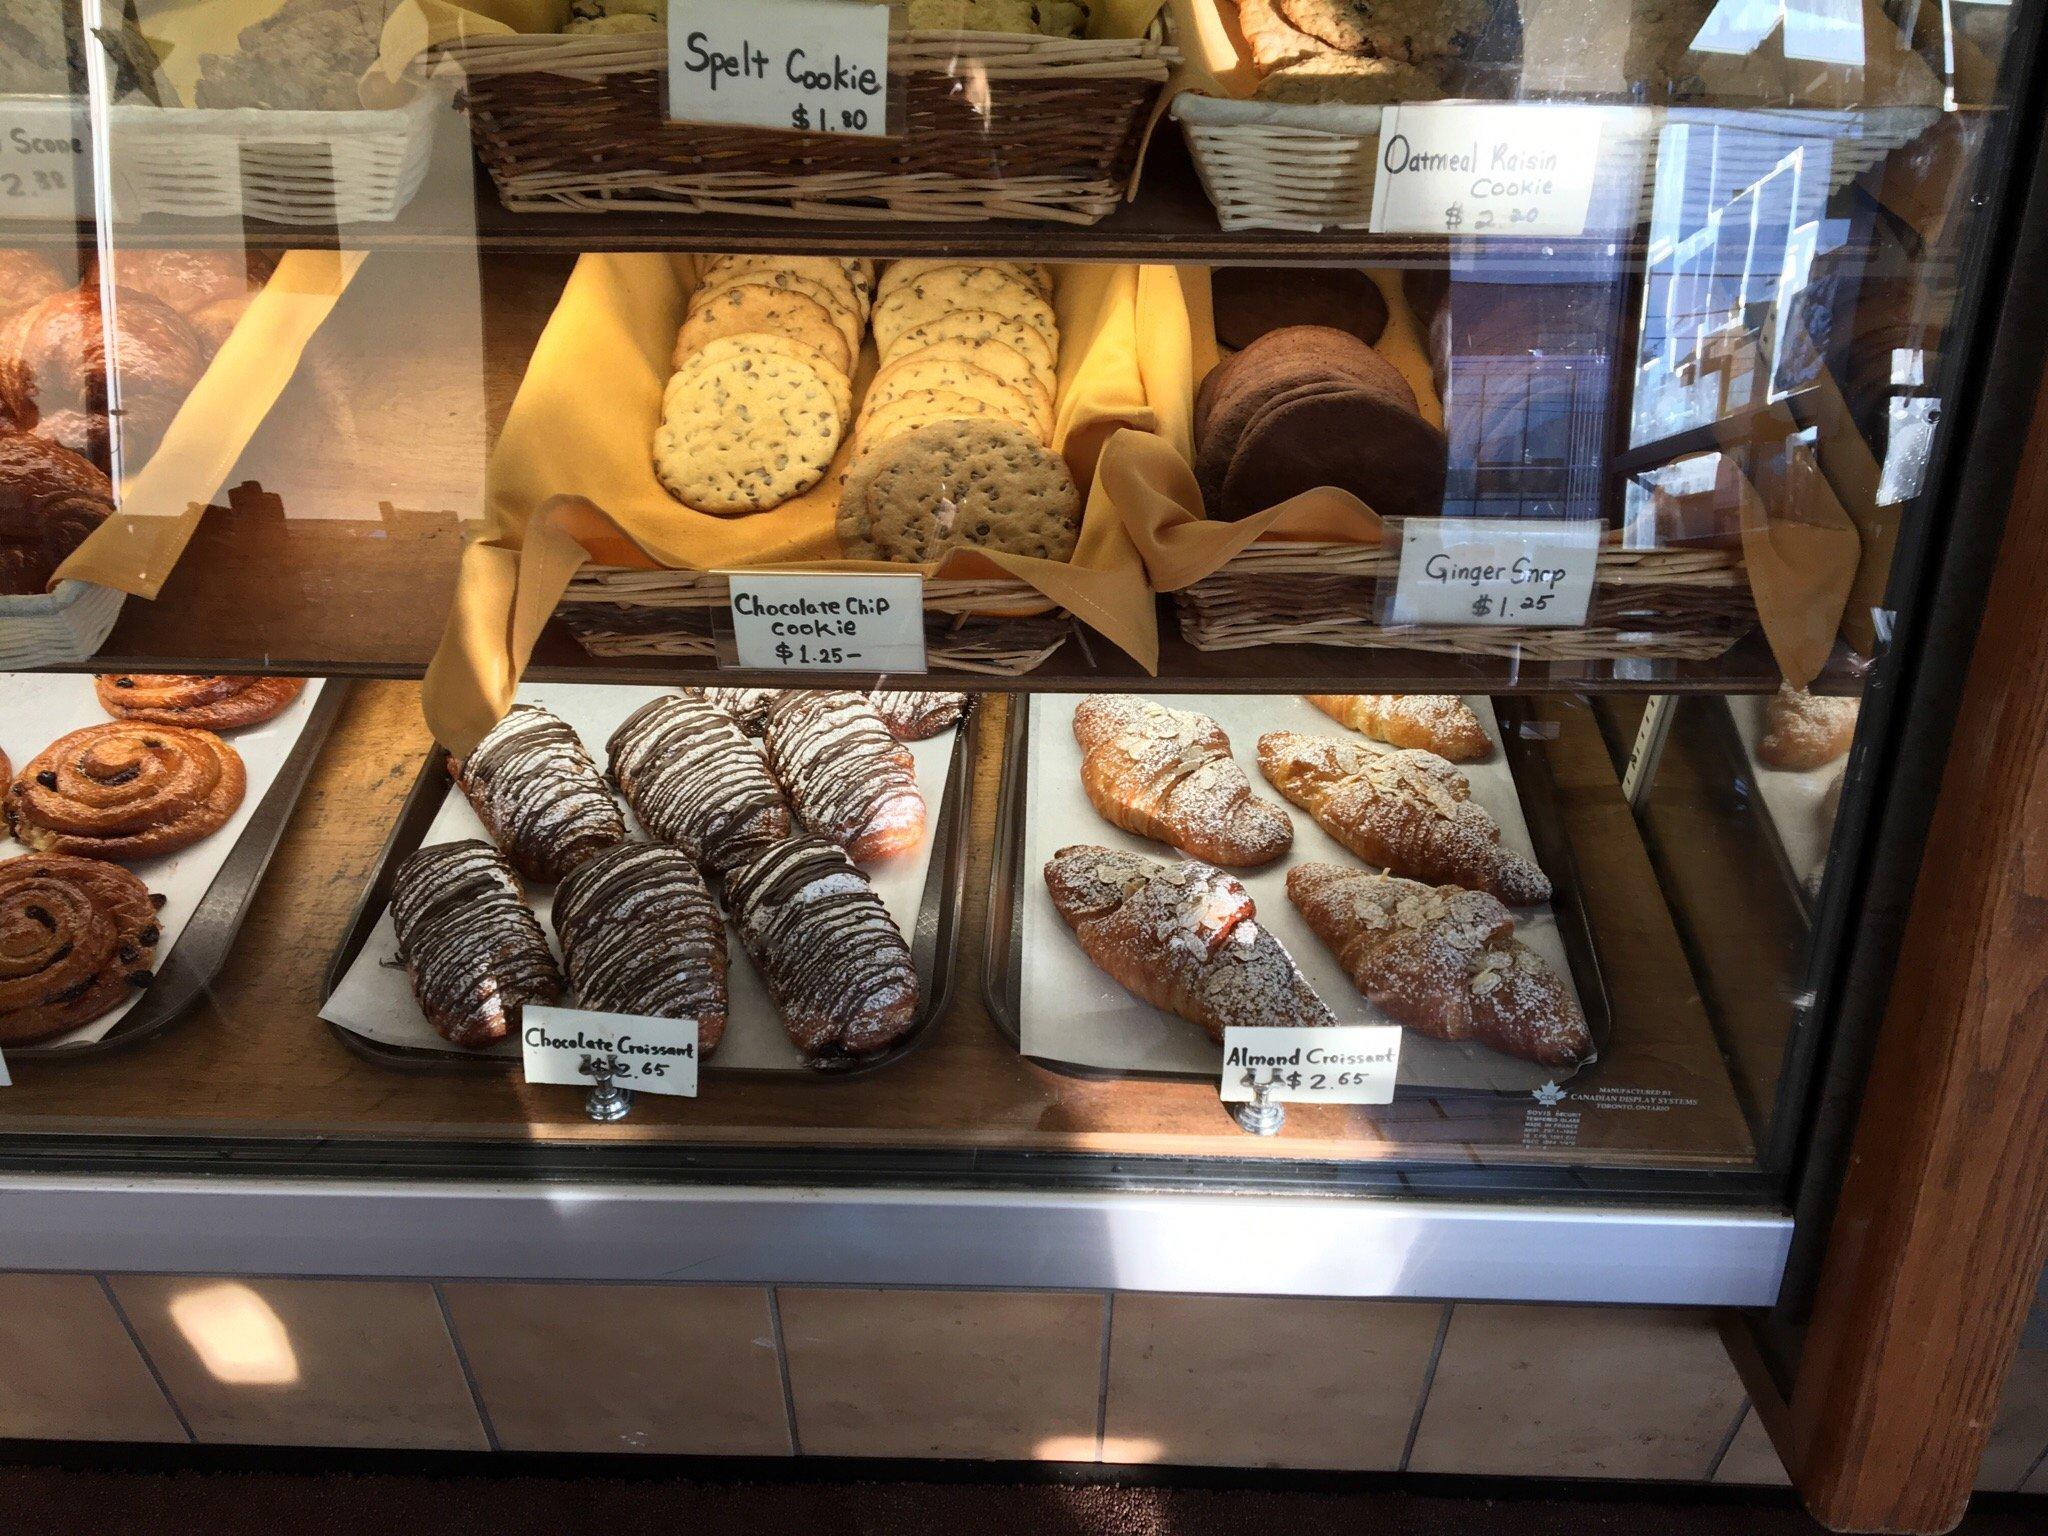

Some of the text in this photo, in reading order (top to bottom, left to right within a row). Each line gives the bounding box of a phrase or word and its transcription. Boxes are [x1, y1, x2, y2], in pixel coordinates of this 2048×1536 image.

[685, 31, 882, 95] Spelt Cookie
[792, 103, 868, 131] $1.80
[10, 127, 84, 154] Scone
[1384, 134, 1557, 174] Oatmeal Raisin
[1470, 178, 1554, 198] Cookie
[1425, 554, 1506, 586] Ginger
[734, 592, 840, 616] Chocolate
[1472, 594, 1555, 618] $1.25
[525, 1027, 694, 1058] Chocolate Croissant
[1227, 1047, 1395, 1066] Almond Croissant
[1287, 1071, 1370, 1090] $2.65
[1599, 1087, 1661, 1096] MANUFACTURED
[1570, 1093, 1699, 1106] CANADIAN DISPLAY SYSTEMS
[1635, 1104, 1670, 1112] ONTARIO
